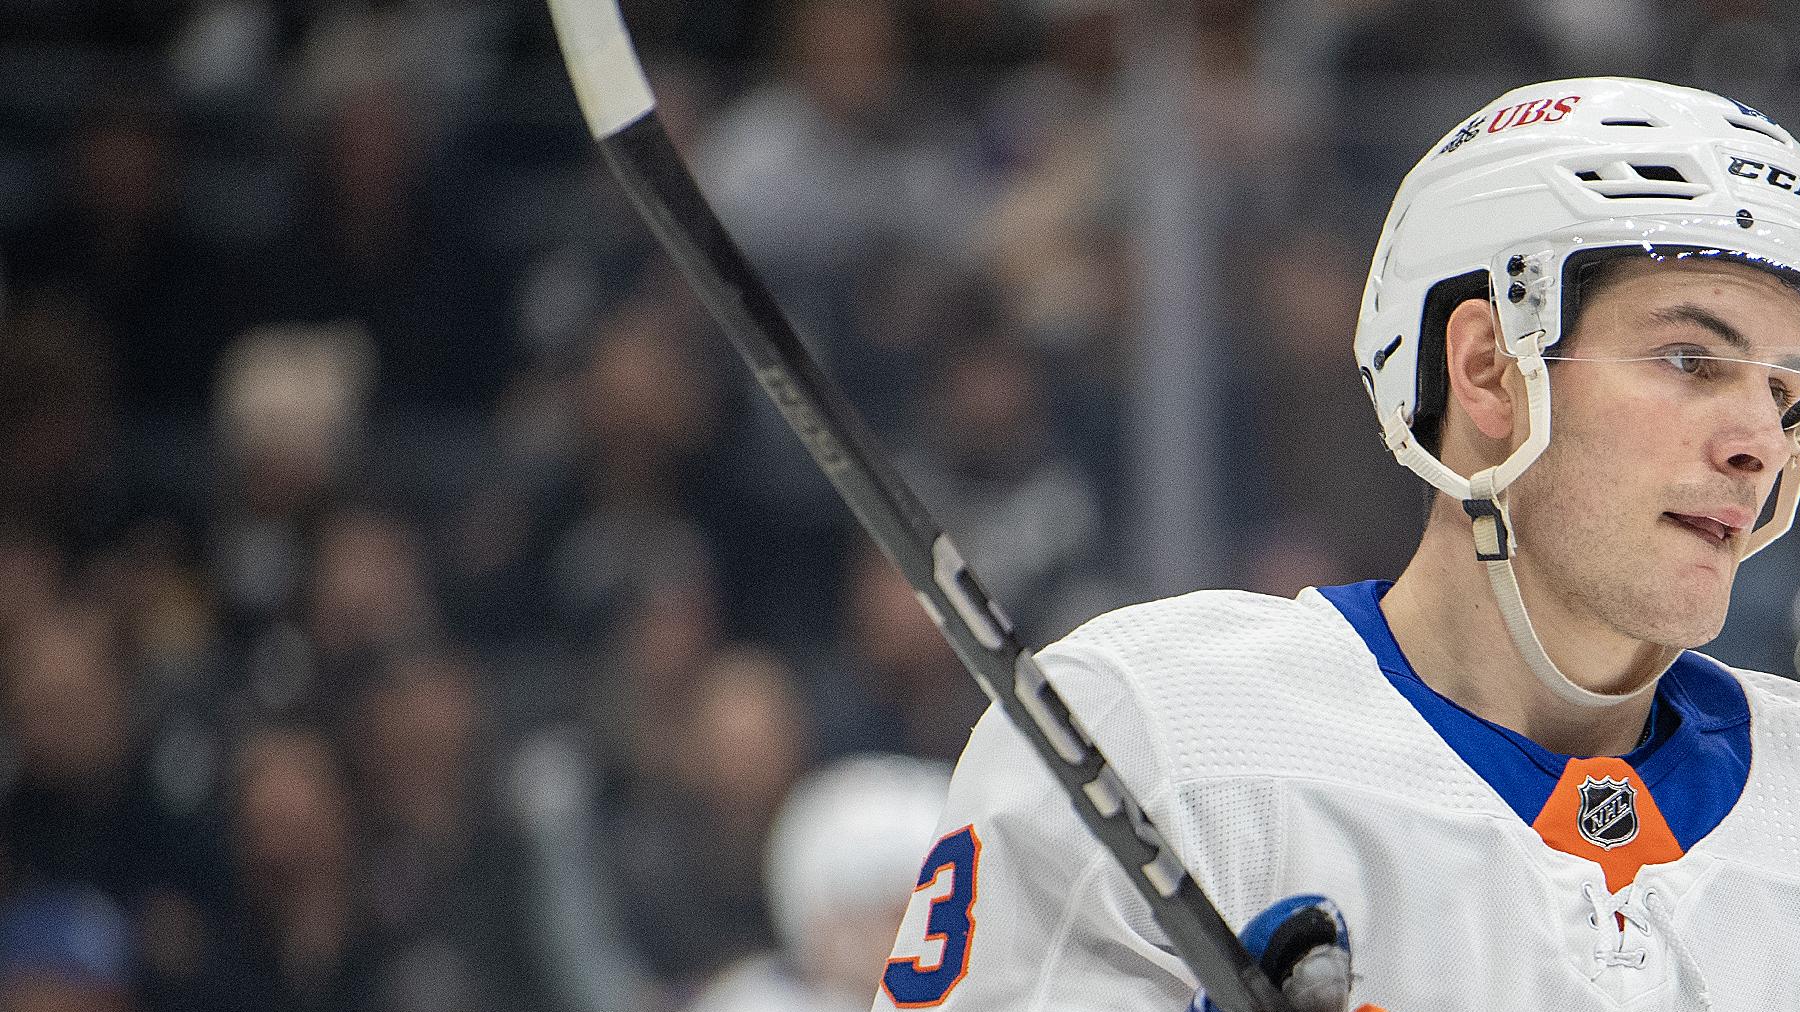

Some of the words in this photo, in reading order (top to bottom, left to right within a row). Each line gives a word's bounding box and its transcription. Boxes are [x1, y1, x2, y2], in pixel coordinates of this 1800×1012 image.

[1488, 97, 1581, 133] UBS
[1590, 796, 1629, 833] NHL
[880, 825, 982, 1008] 3
